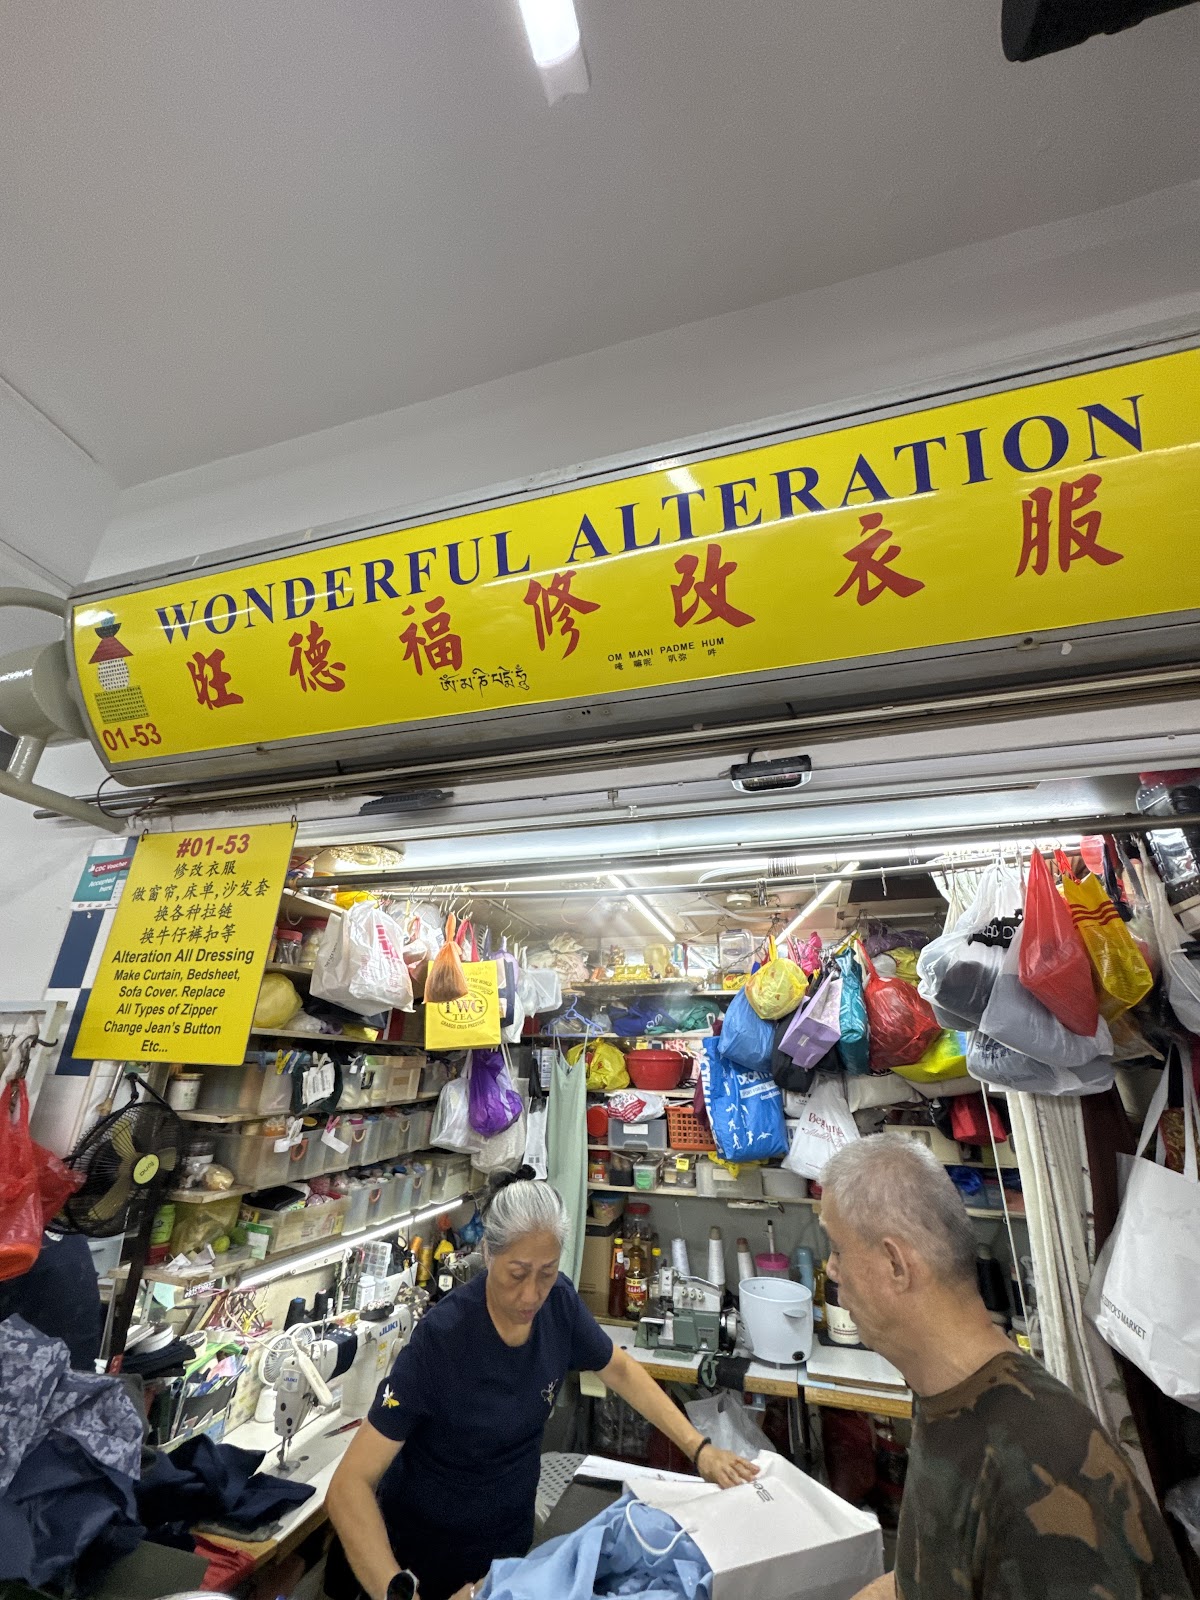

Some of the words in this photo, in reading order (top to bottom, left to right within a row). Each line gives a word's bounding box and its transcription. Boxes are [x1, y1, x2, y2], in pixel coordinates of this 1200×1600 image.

[155, 530, 531, 644] WONDERFUL
[567, 393, 1145, 563] ALTERATION
[607, 653, 622, 662] OM
[628, 648, 654, 659] MANI
[660, 641, 695, 654] PADME
[701, 637, 725, 648] HUM
[102, 723, 162, 751] 01-53
[176, 833, 251, 859] #01-53
[173, 859, 237, 880] 修改衣服
[153, 902, 234, 922] 换各种拉链
[139, 923, 236, 946] 换牛仔裤扣等
[112, 950, 172, 964] Alteration
[174, 948, 193, 963] All
[195, 947, 255, 965] Dressing
[114, 969, 140, 981] Make
[143, 969, 183, 982] Curtain,
[187, 968, 240, 982] Bedsheet,
[118, 985, 142, 998] Sofa
[144, 985, 178, 998] Cover.
[181, 985, 226, 1000] Replace
[116, 1003, 132, 1015] All
[134, 1003, 165, 1018] Types
[167, 1003, 181, 1015] of
[181, 1003, 218, 1019] Zipper
[441, 999, 485, 1014] TWG
[104, 1020, 143, 1036] Change
[144, 1021, 181, 1034] Jean's
[183, 1022, 221, 1035] Button
[140, 1039, 168, 1052] Etc...
[379, 1320, 398, 1337] JUKI
[1121, 1312, 1146, 1340] MARKET
